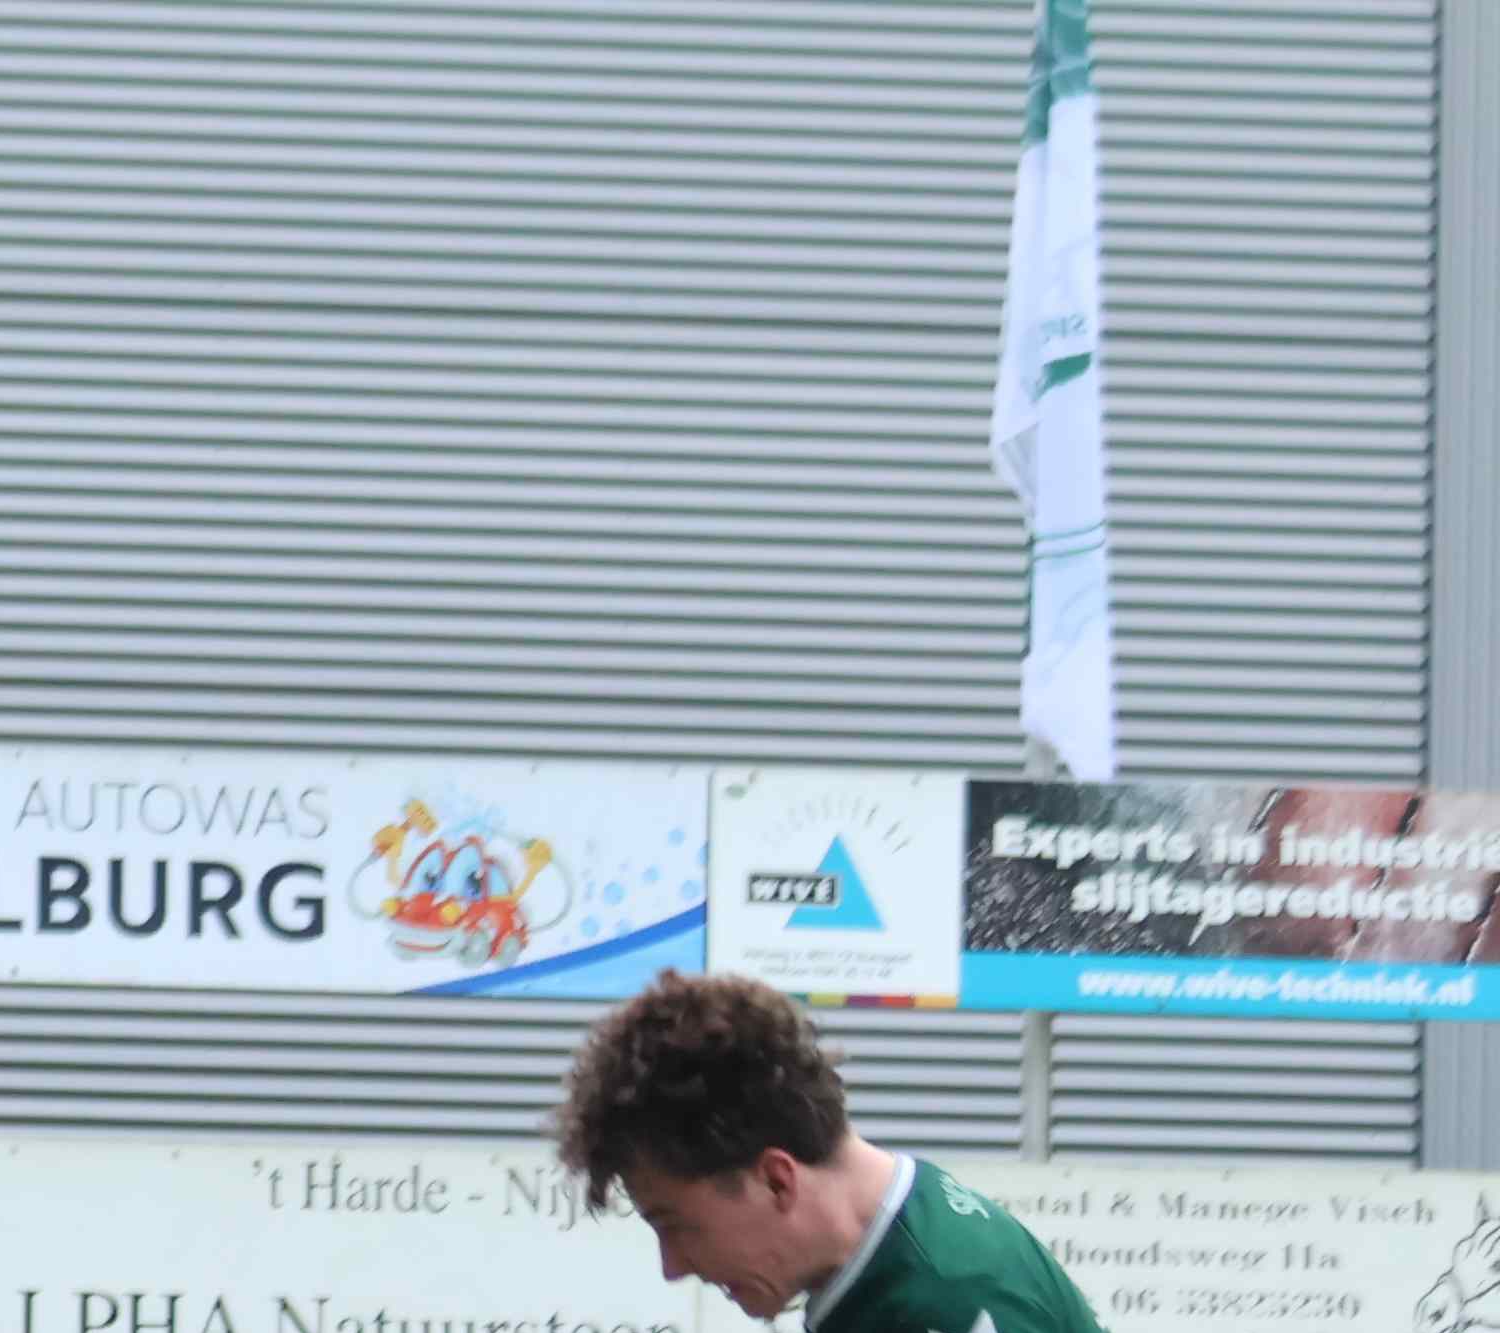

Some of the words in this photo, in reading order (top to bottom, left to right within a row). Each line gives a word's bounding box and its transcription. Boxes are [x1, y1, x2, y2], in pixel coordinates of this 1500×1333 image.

[16, 778, 329, 841] AUTOWAS
[993, 817, 1197, 870] Experts
[1212, 822, 1265, 866] in
[1071, 873, 1480, 926] slijtagereductie
[302, 1160, 450, 1215] Harde
[1159, 1192, 1310, 1227] Manege
[1328, 1194, 1436, 1225] Visch
[1111, 1287, 1160, 1315] 06
